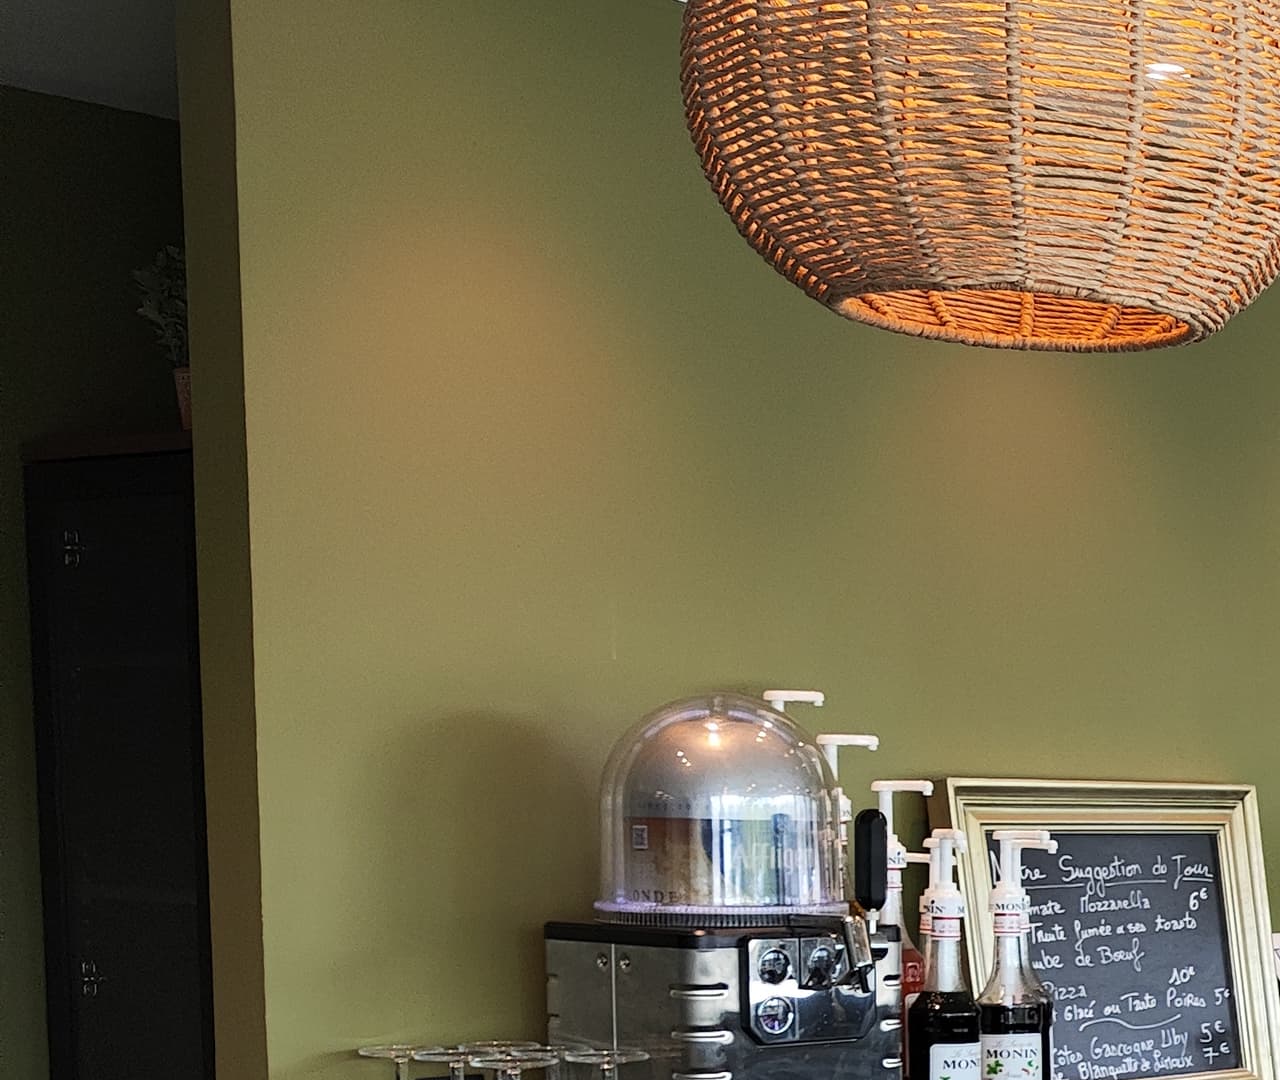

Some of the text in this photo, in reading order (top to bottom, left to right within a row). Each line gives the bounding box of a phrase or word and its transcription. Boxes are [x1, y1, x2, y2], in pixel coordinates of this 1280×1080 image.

[989, 850, 1047, 885] Ntre
[1058, 855, 1143, 897] Suggestion
[1171, 855, 1214, 889] Jour
[1029, 900, 1066, 916] mate
[1080, 890, 1151, 913] Mozzarella
[1075, 947, 1095, 967] de
[1064, 1001, 1096, 1022] Glacé
[1103, 1003, 1121, 1015] ou
[1166, 987, 1207, 1008] Poires
[986, 1048, 1038, 1059] MONIN
[1160, 1028, 1188, 1058] Uby
[943, 1058, 980, 1070] MON
